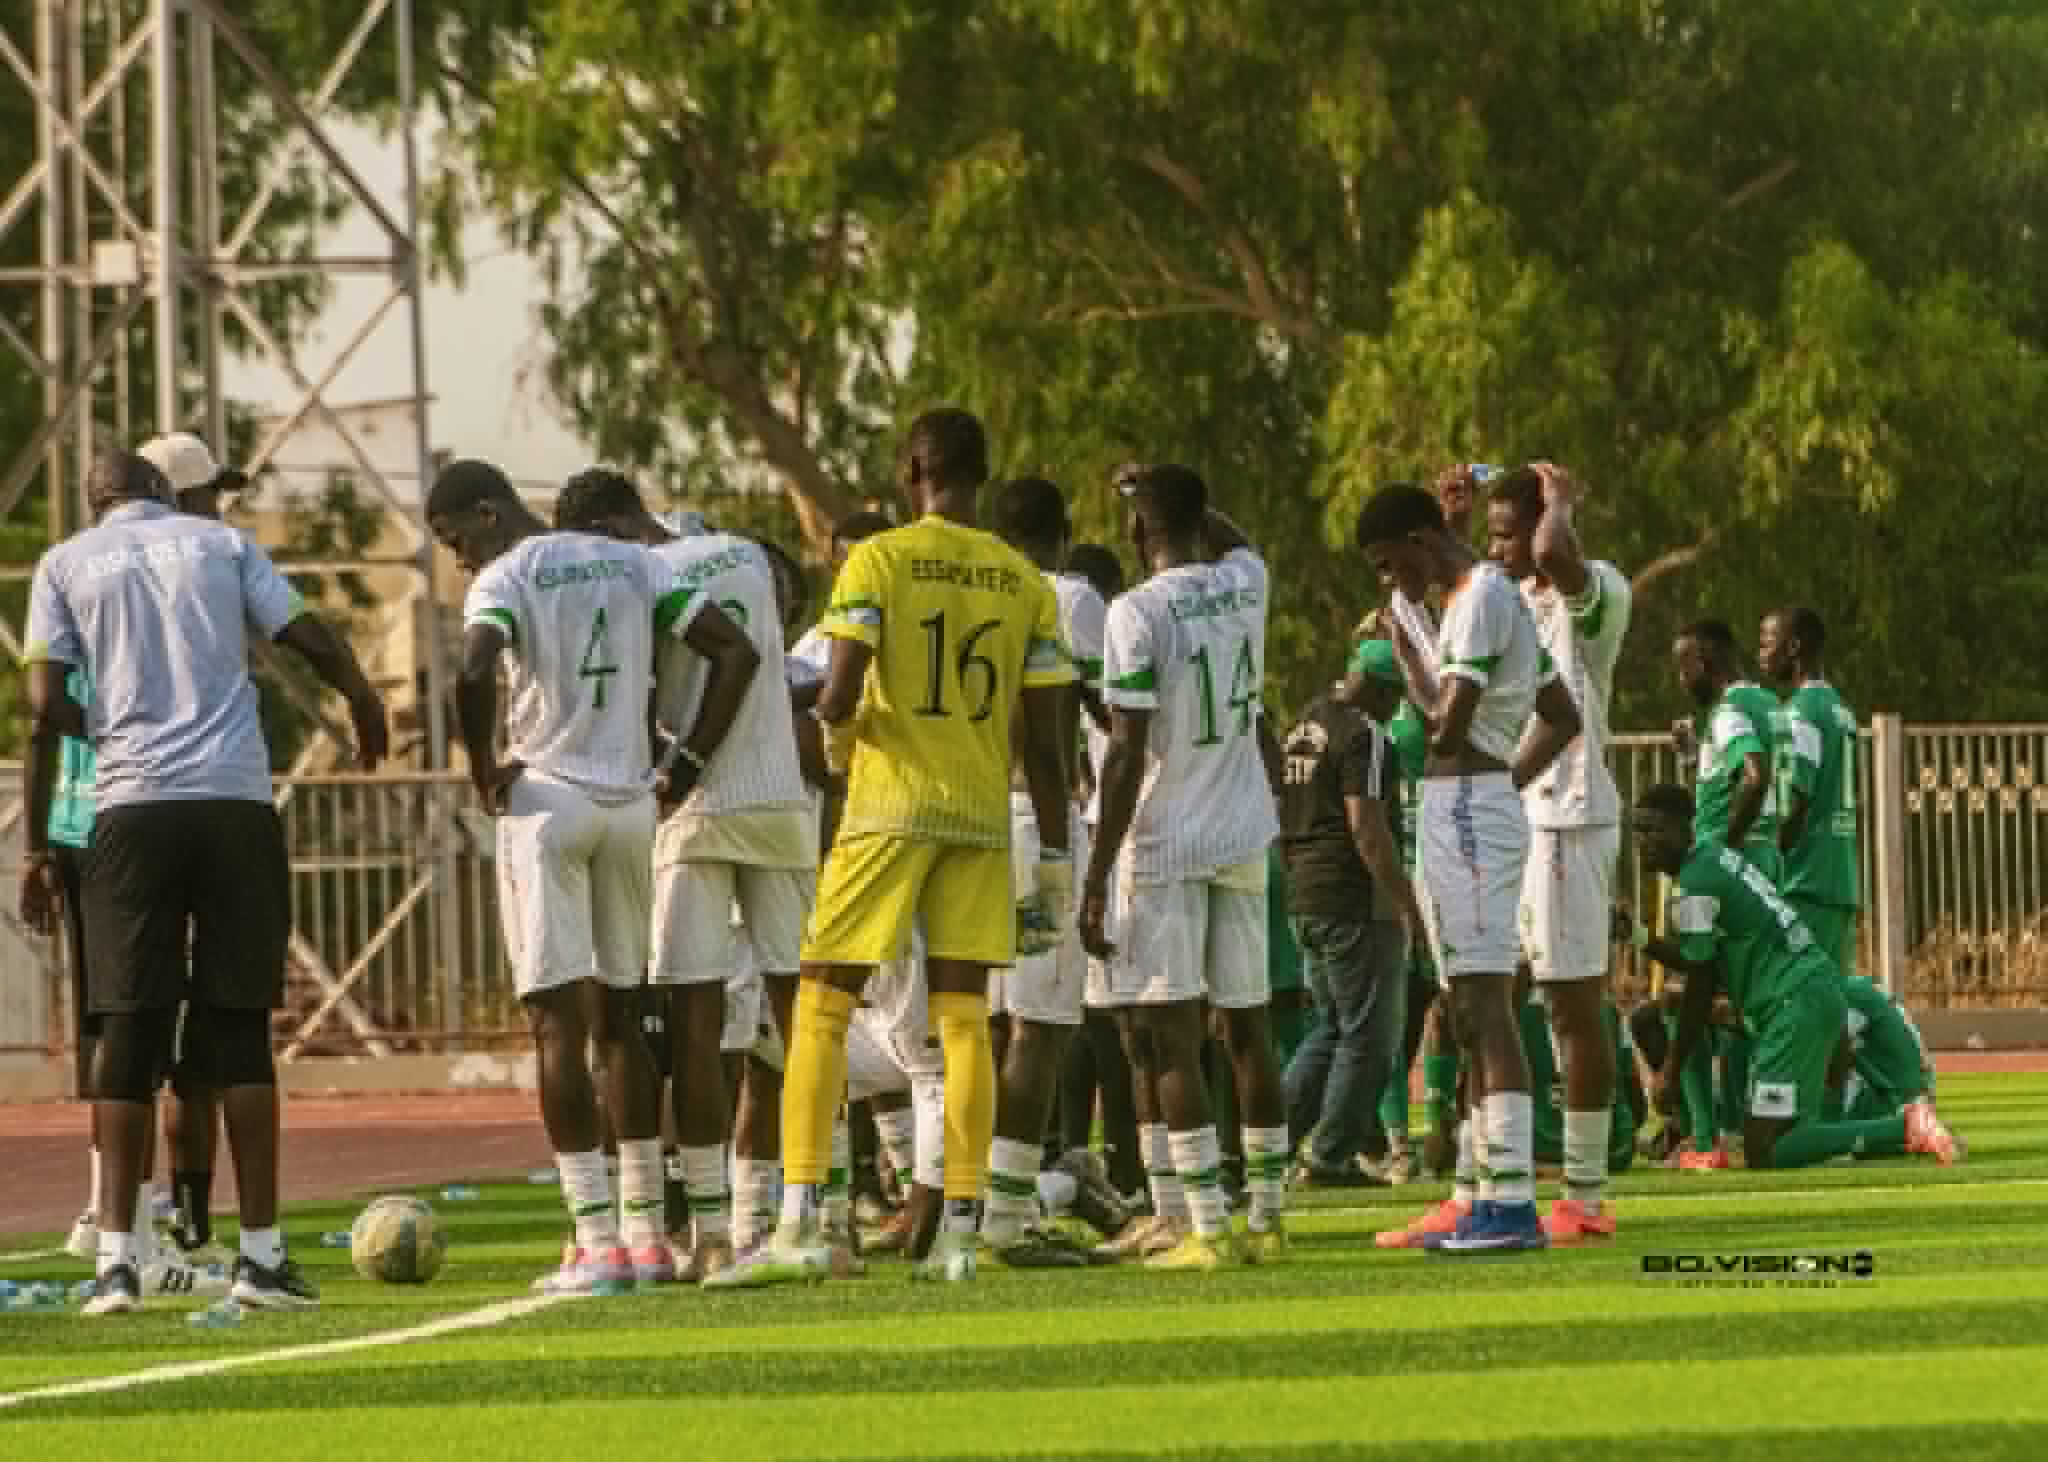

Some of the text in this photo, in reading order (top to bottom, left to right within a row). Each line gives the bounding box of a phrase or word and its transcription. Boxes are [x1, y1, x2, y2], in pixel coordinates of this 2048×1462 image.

[578, 606, 620, 709] 4
[912, 608, 1001, 723] 16
[1188, 636, 1263, 749] 14
